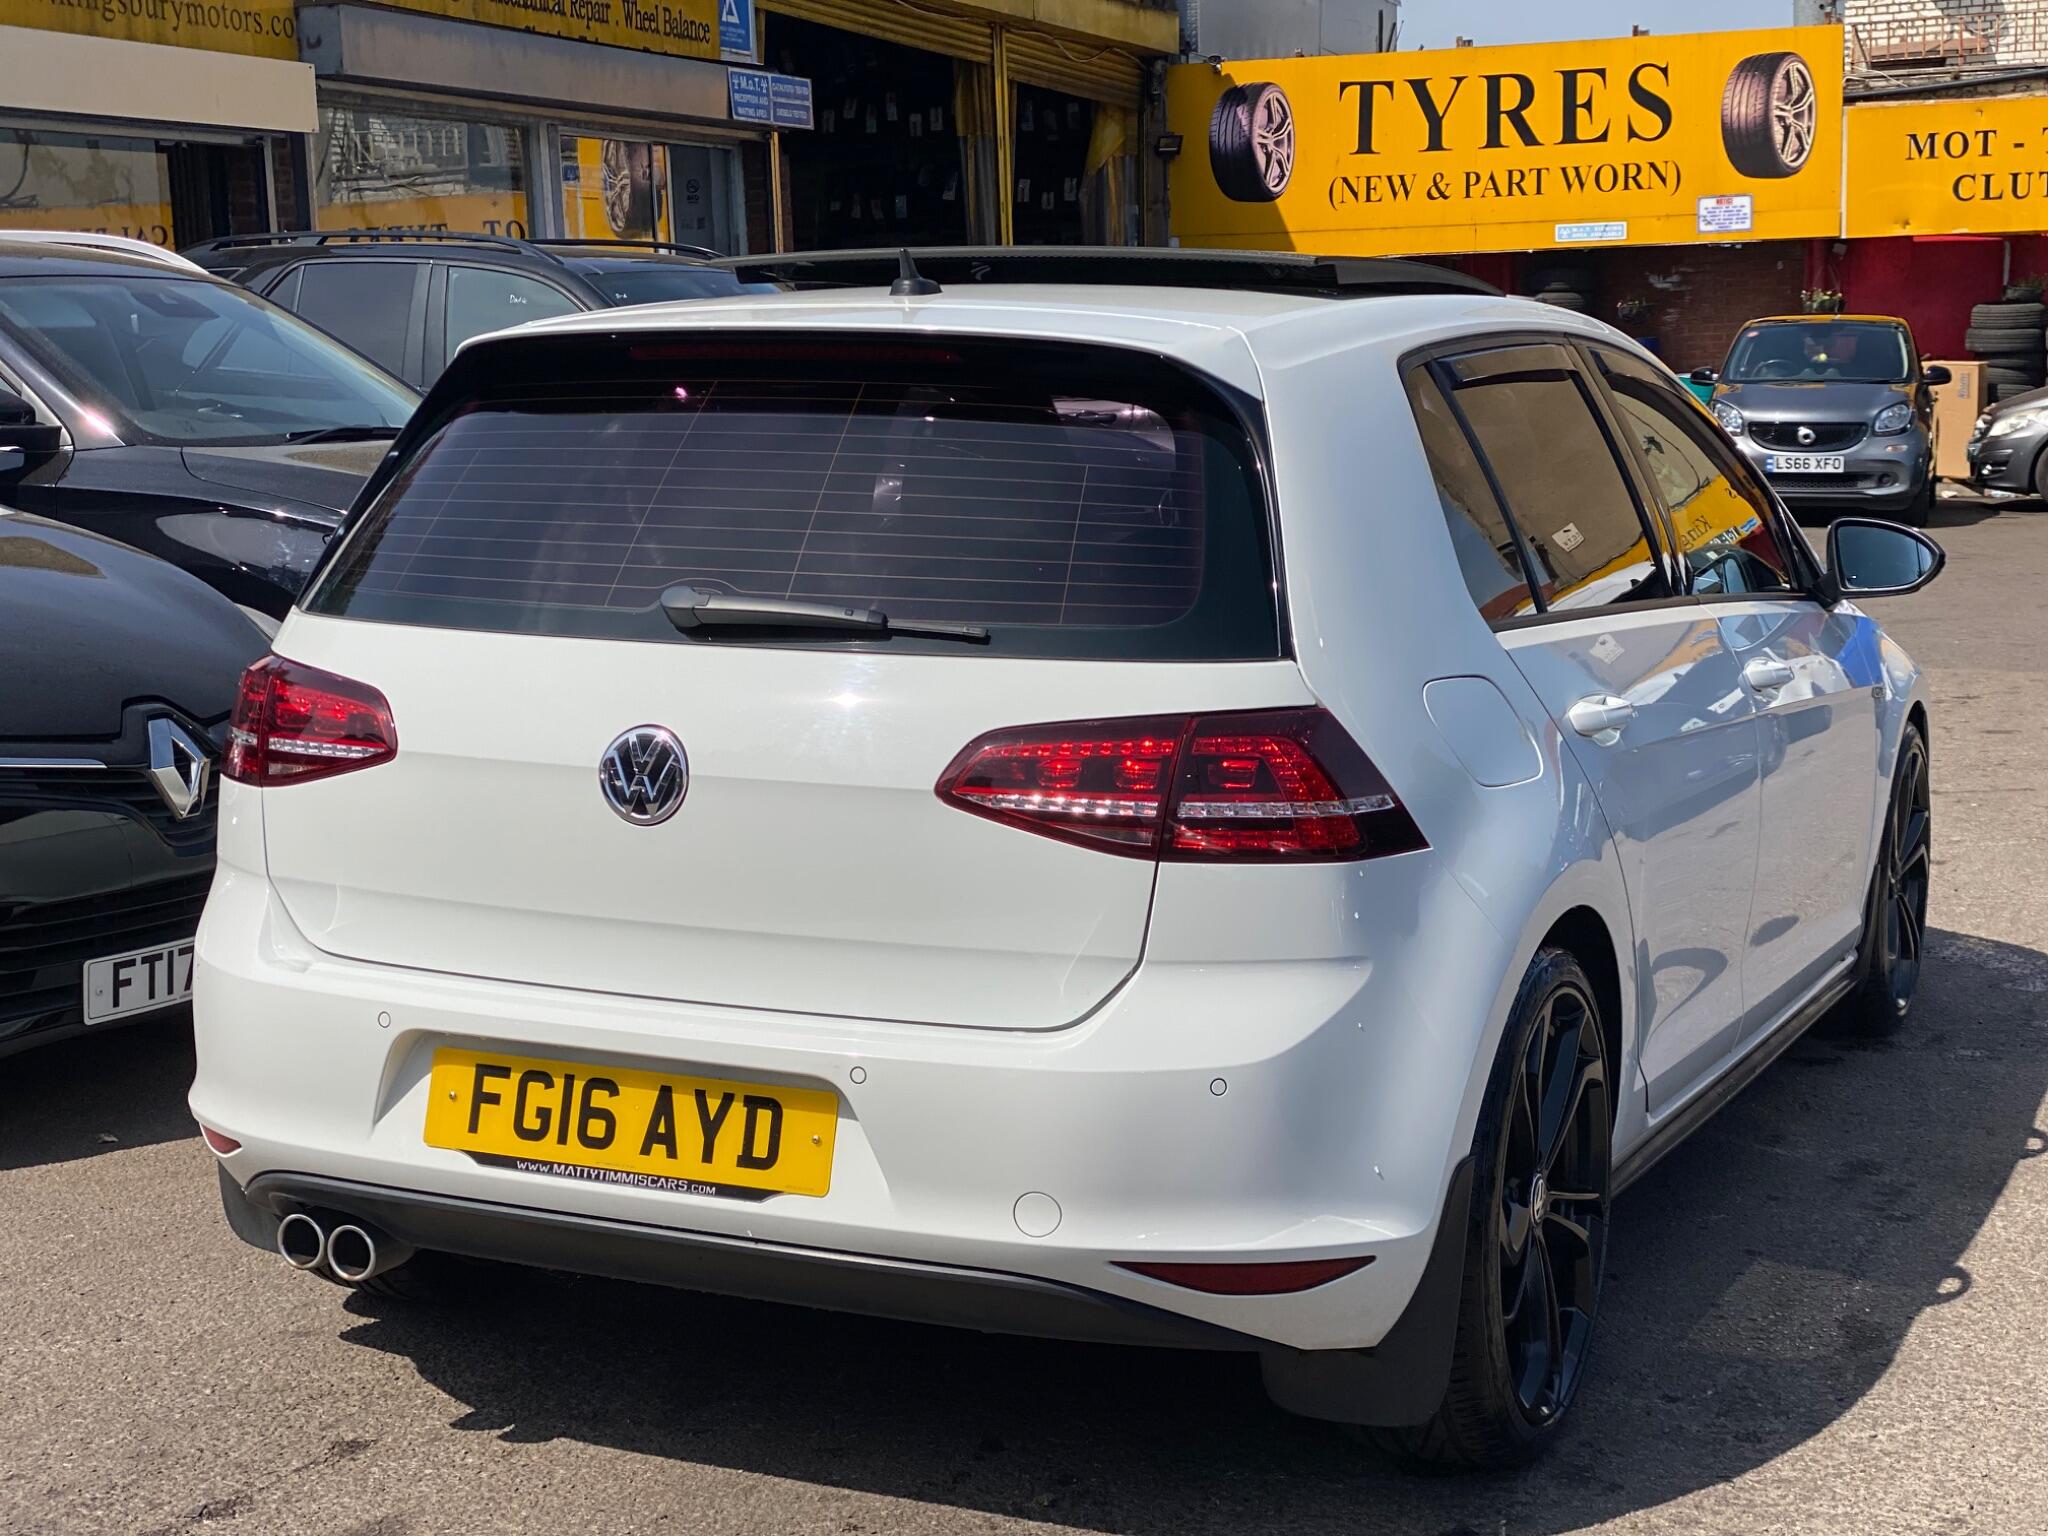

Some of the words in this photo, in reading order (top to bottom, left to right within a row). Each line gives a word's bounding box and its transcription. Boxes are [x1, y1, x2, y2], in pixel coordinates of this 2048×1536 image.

[622, 0, 659, 34] Wheel
[663, 7, 711, 43] Balance
[1339, 62, 1673, 155] TYRES
[1905, 129, 1997, 161] MOT
[1328, 172, 1416, 211] (NEW
[1427, 176, 1451, 201] &
[1464, 167, 1549, 200] PART
[1560, 160, 1682, 197] WORN)
[1776, 457, 1811, 470] LS66
[113, 944, 195, 1009] FT17
[467, 1063, 620, 1151] FG16
[639, 1085, 784, 1171] AYD
